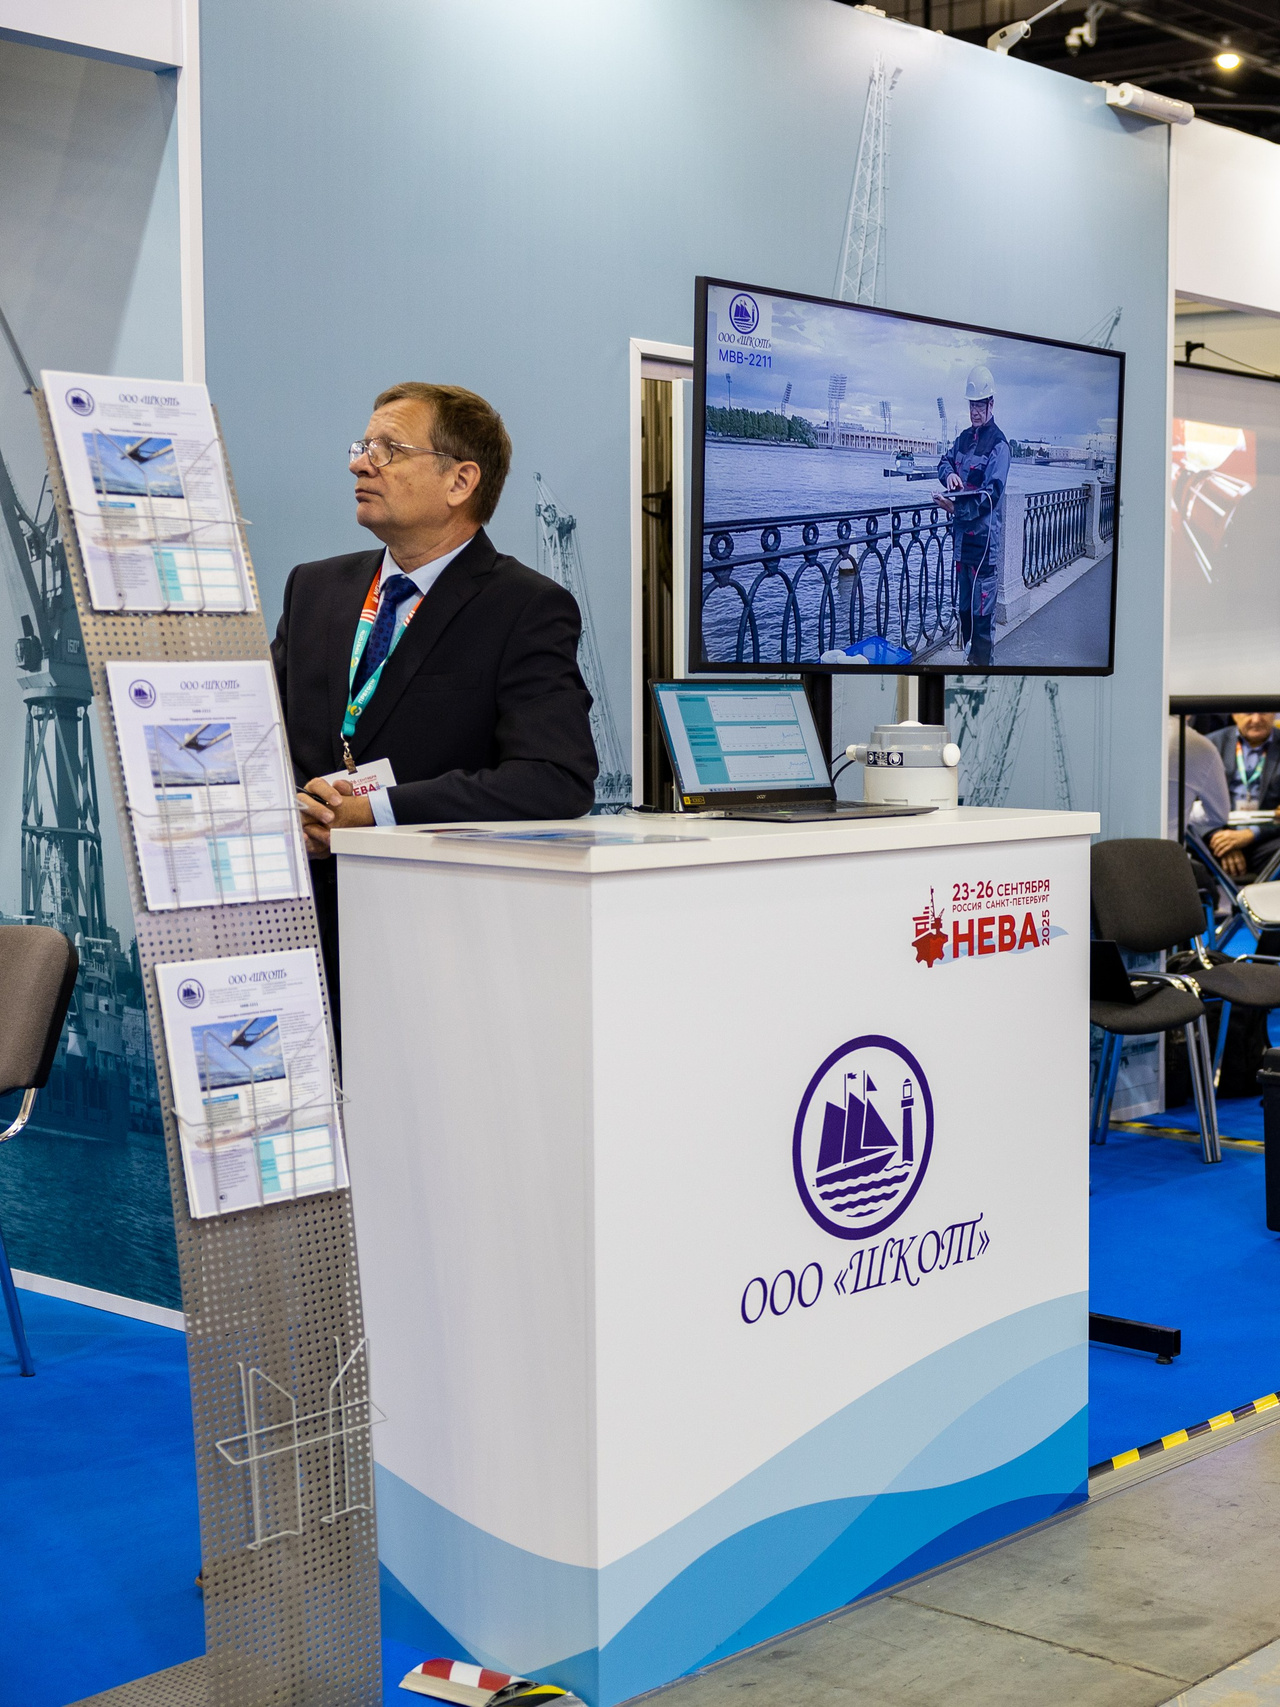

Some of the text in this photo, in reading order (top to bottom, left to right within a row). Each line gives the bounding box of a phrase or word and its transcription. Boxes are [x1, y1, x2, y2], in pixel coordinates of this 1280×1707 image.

[718, 332, 772, 349] ООО «ШКОТ»
[719, 348, 772, 369] МВВ-2211
[118, 393, 139, 404] ООО
[180, 679, 240, 692] ООО «ШКОТ»
[353, 783, 377, 797] ЕВА
[952, 879, 1050, 902] 23-26 СЕНТЯБРЯ
[952, 894, 1050, 913] РОССИЯ САНКТ-ПЕТЕРБУРГ
[952, 911, 1041, 959] НЕВА
[1041, 909, 1050, 946] 2025
[228, 968, 288, 985] ООО «ШКОТ»
[740, 1212, 991, 1325] ООО «ШКОТ»
